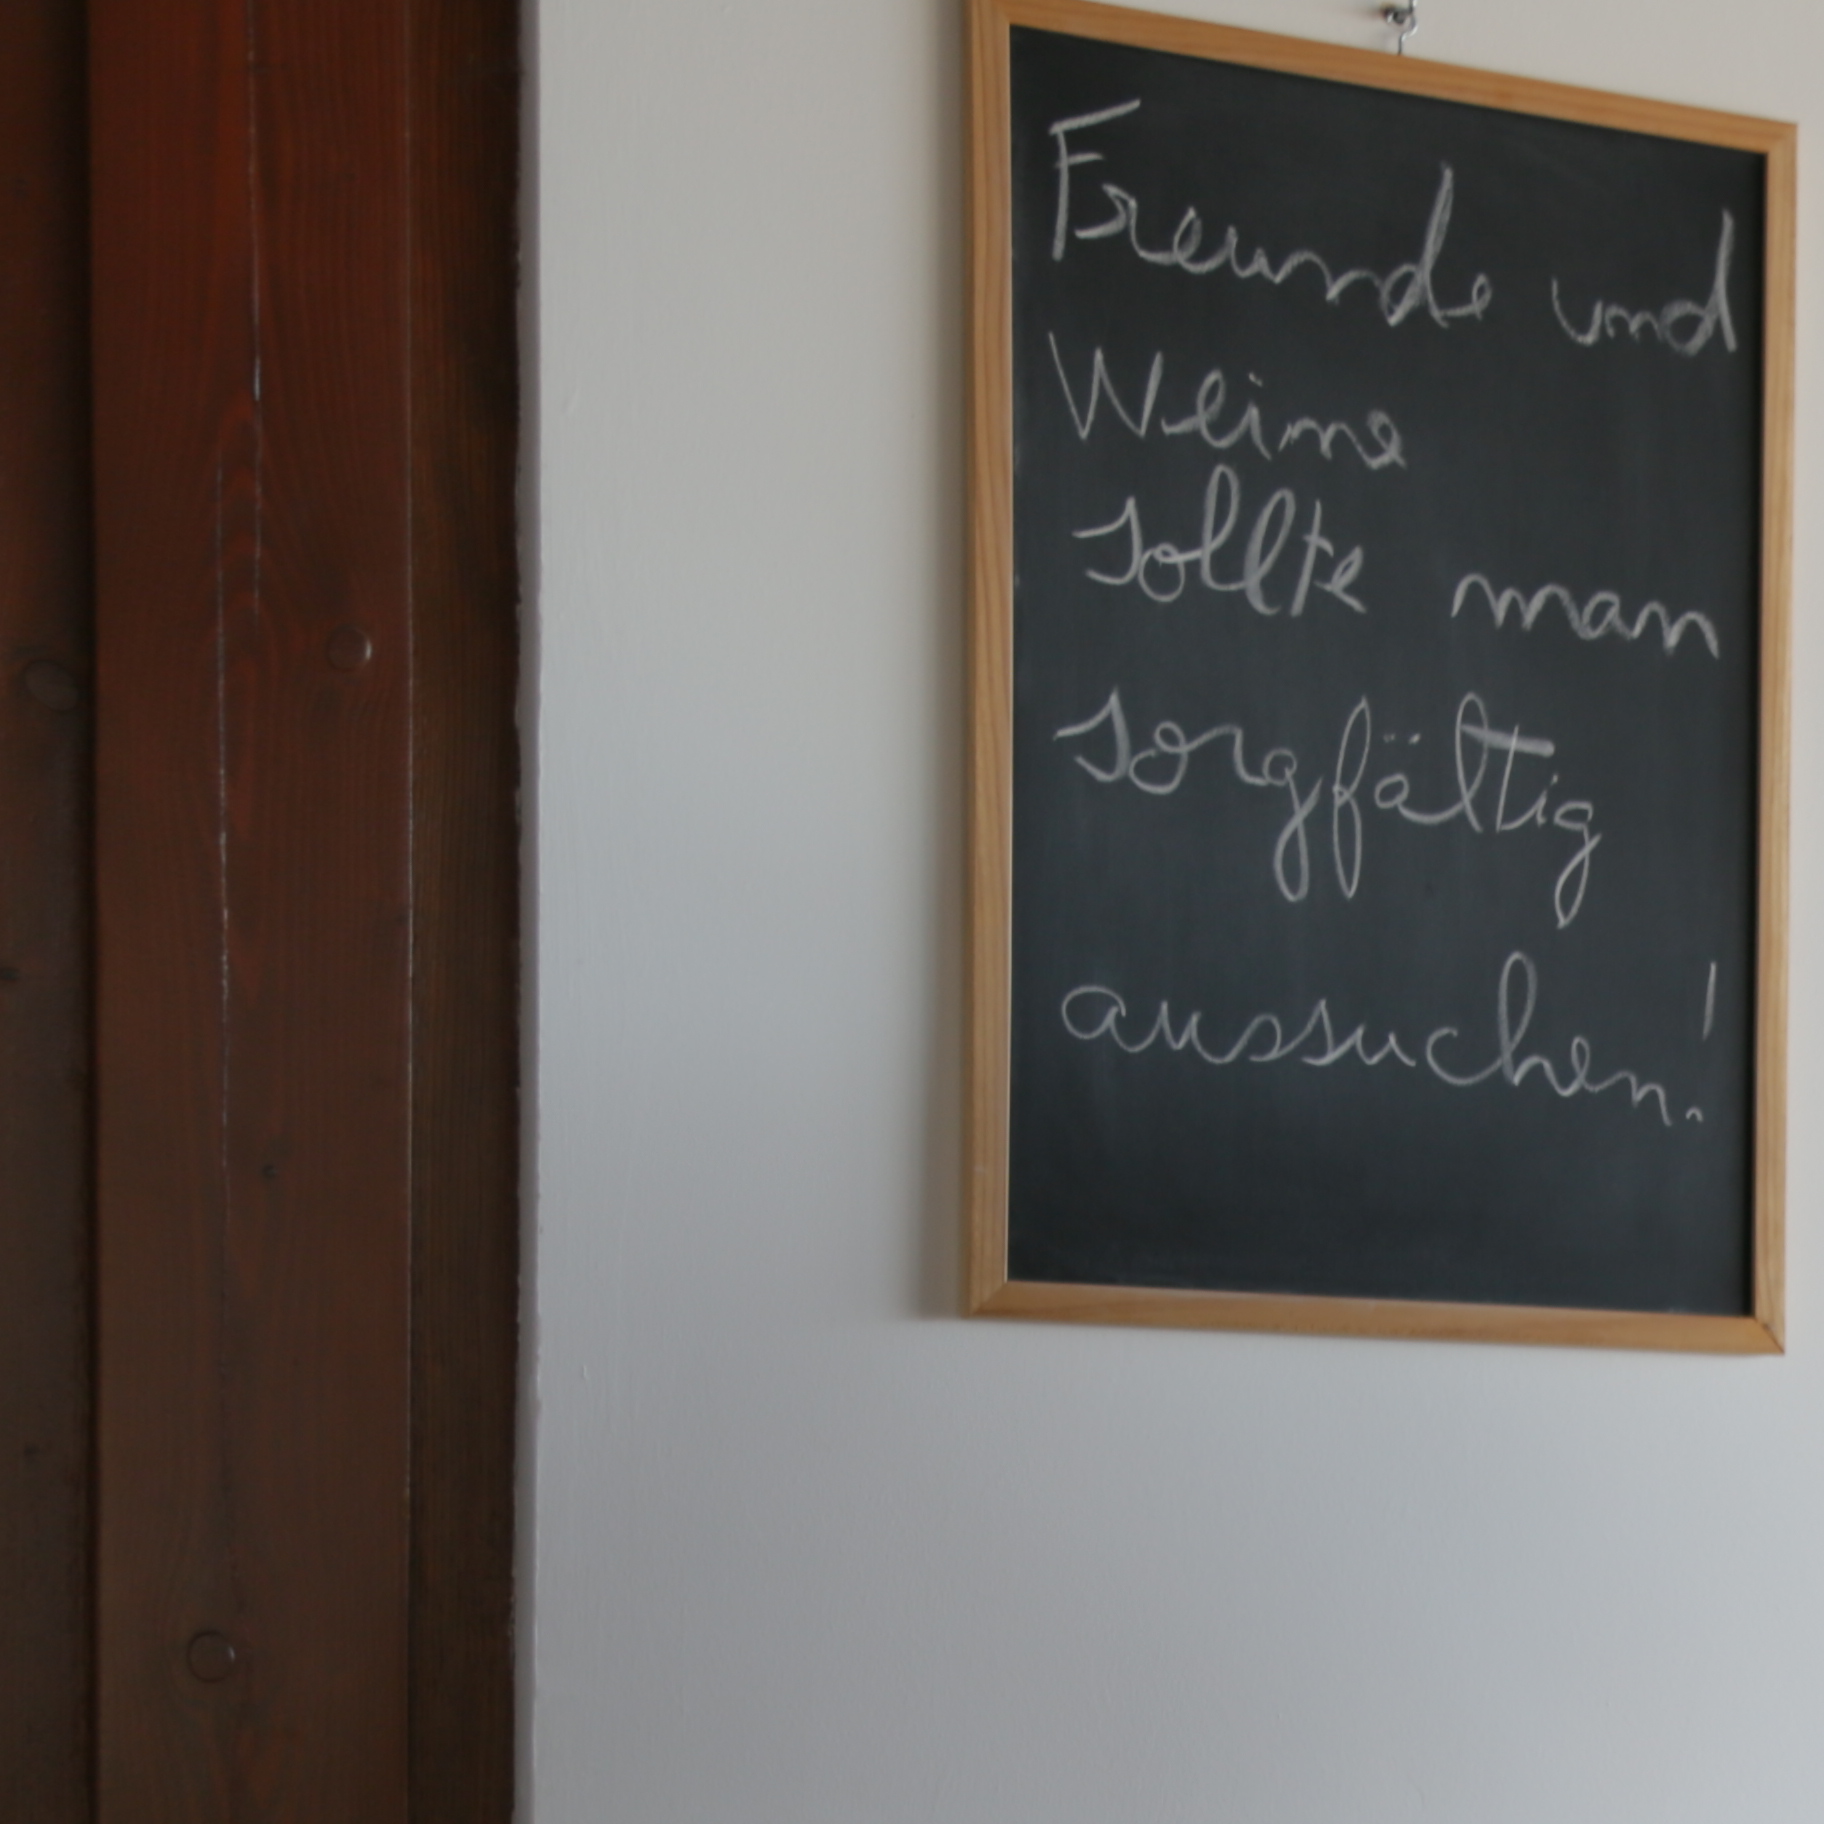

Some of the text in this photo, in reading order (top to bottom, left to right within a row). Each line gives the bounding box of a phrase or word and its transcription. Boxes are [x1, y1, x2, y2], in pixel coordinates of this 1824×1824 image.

[1049, 98, 1737, 352] Freunde und
[1048, 332, 1406, 469] Weine
[1452, 573, 1719, 660] man
